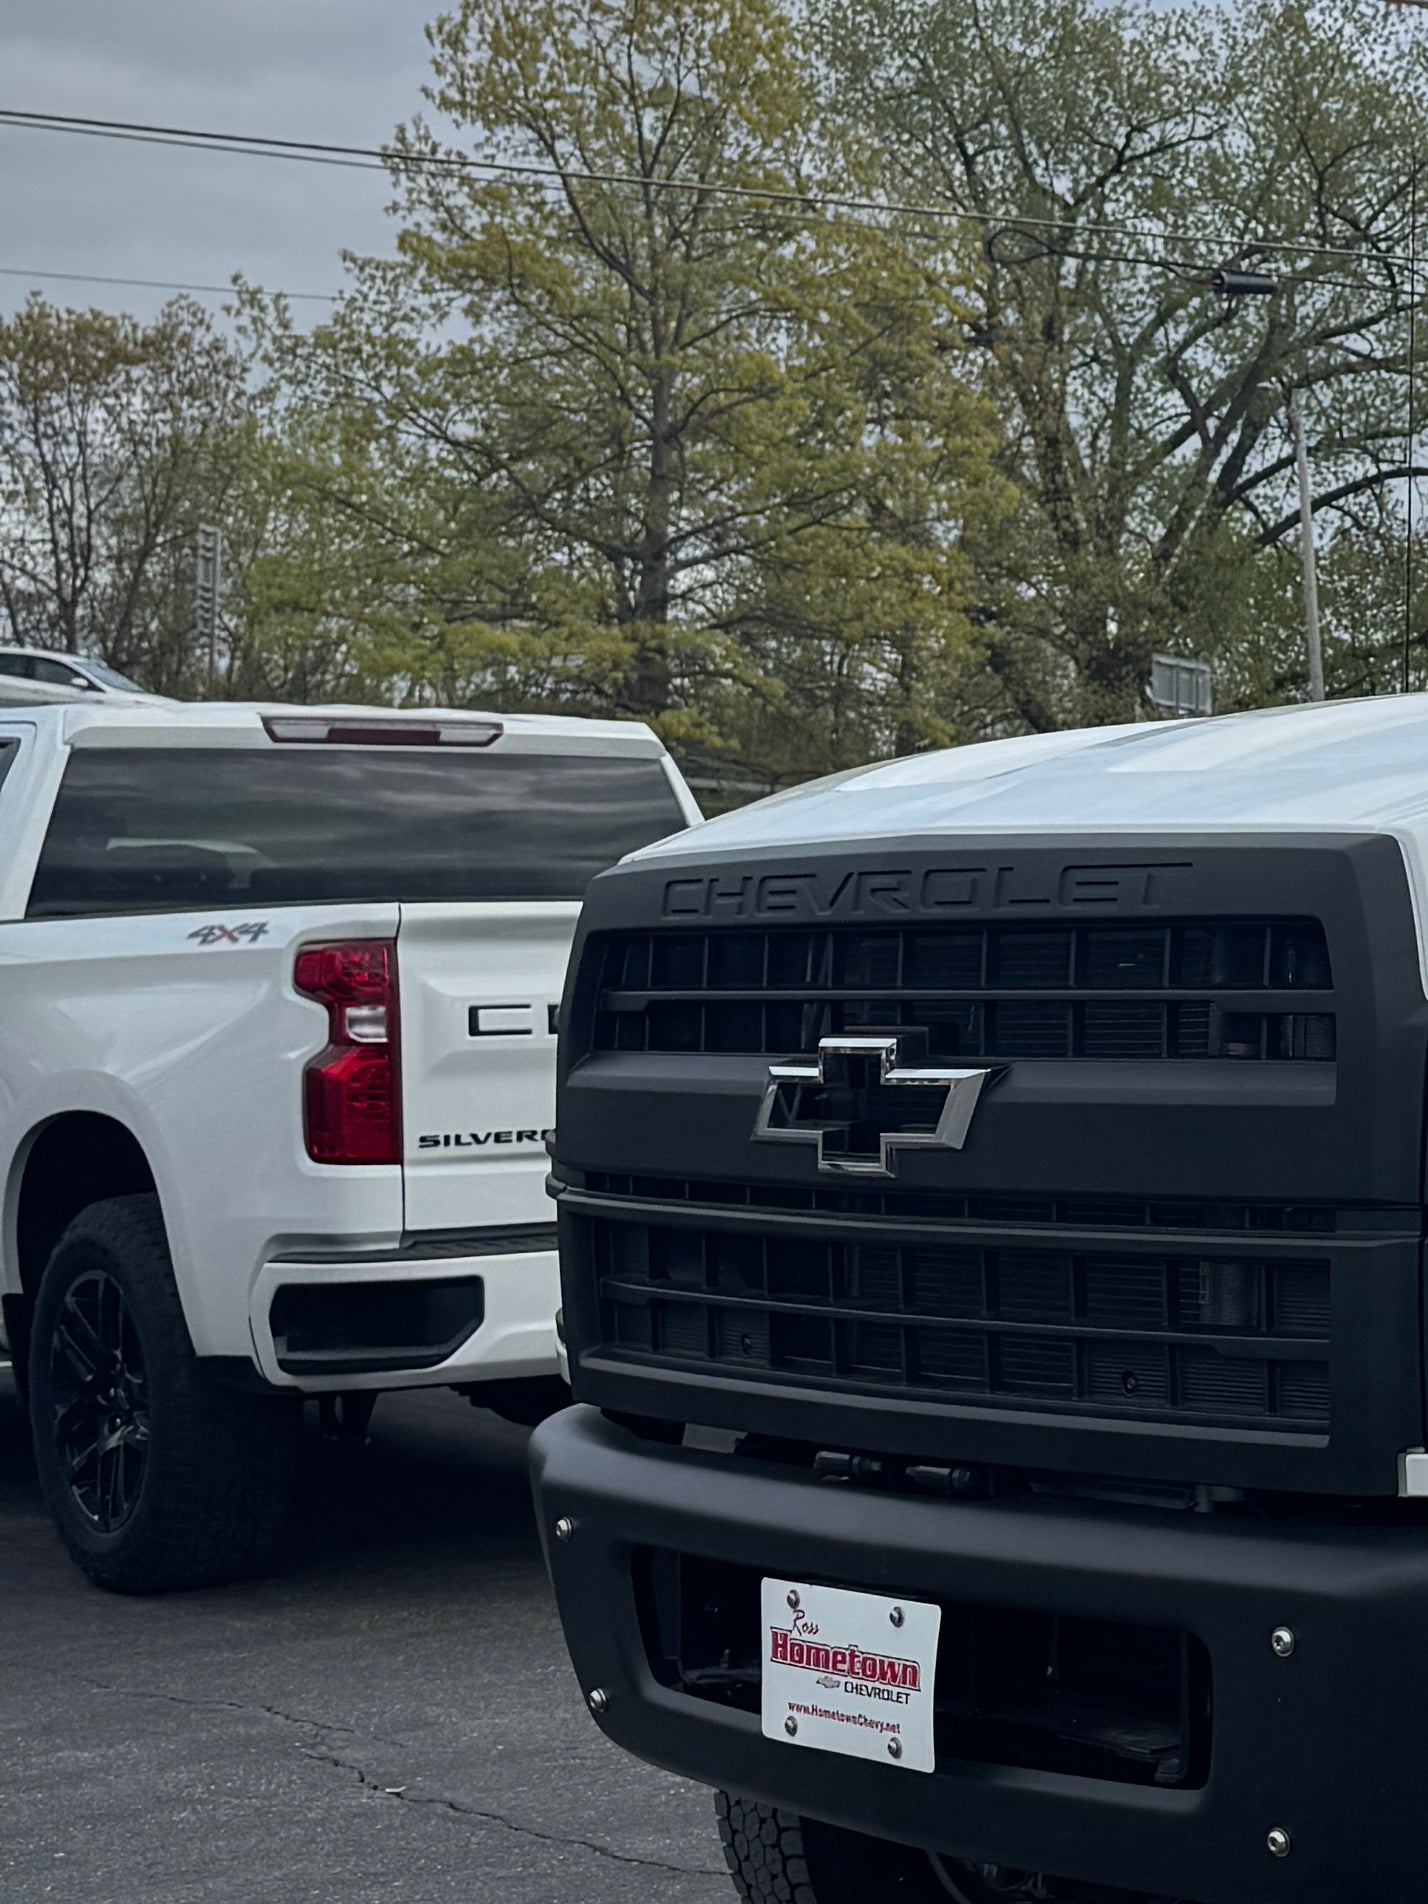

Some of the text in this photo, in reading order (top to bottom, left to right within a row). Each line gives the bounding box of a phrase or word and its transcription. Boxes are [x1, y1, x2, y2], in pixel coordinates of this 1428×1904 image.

[661, 862, 1193, 919] CHEVROLET
[419, 1129, 553, 1149] SILVER
[792, 1609, 820, 1636] Ross
[771, 1628, 920, 1691] Hometown
[844, 1681, 911, 1705] CHEVROLET
